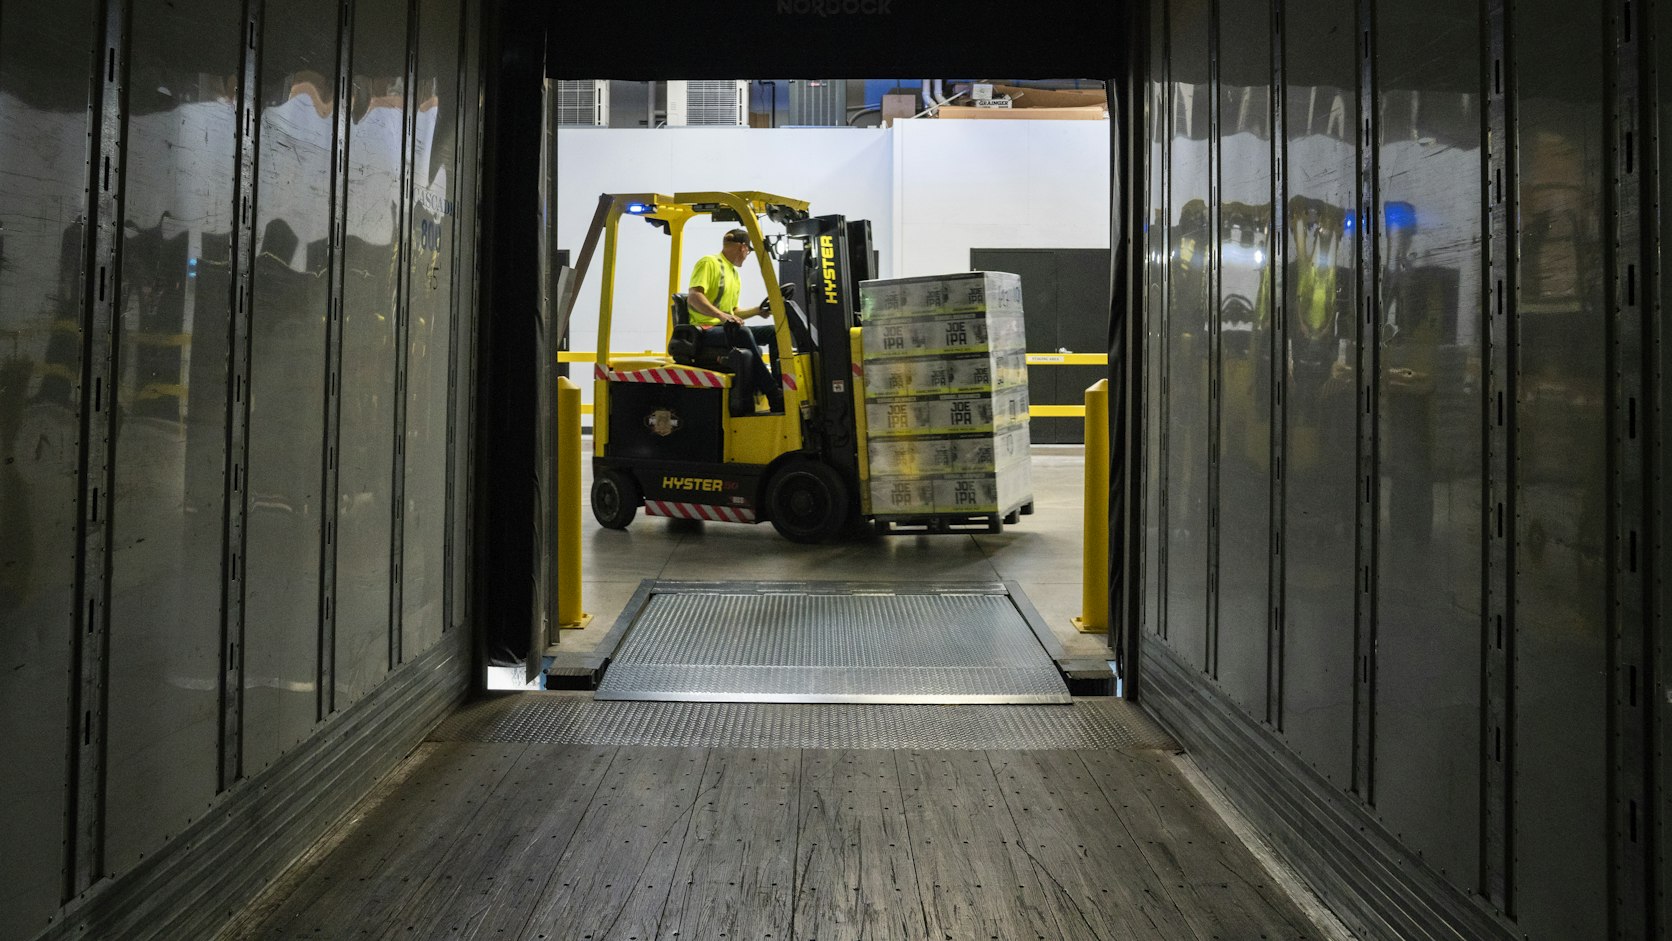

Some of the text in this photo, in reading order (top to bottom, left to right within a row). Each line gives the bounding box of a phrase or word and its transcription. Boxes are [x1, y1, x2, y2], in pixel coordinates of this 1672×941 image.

[820, 235, 838, 304] HYSTER
[883, 325, 903, 337] JOE
[945, 321, 966, 333] JOE
[883, 337, 904, 350] IPA
[946, 332, 967, 346] IPA
[887, 404, 908, 415] JOE
[950, 401, 971, 412] JOE
[887, 415, 909, 428] IPA
[950, 411, 972, 425] IPA
[662, 476, 723, 492] HYSTER
[891, 482, 911, 493] JOE
[955, 481, 975, 492] JOE
[891, 493, 912, 505] IPA
[955, 491, 976, 505] IPA
